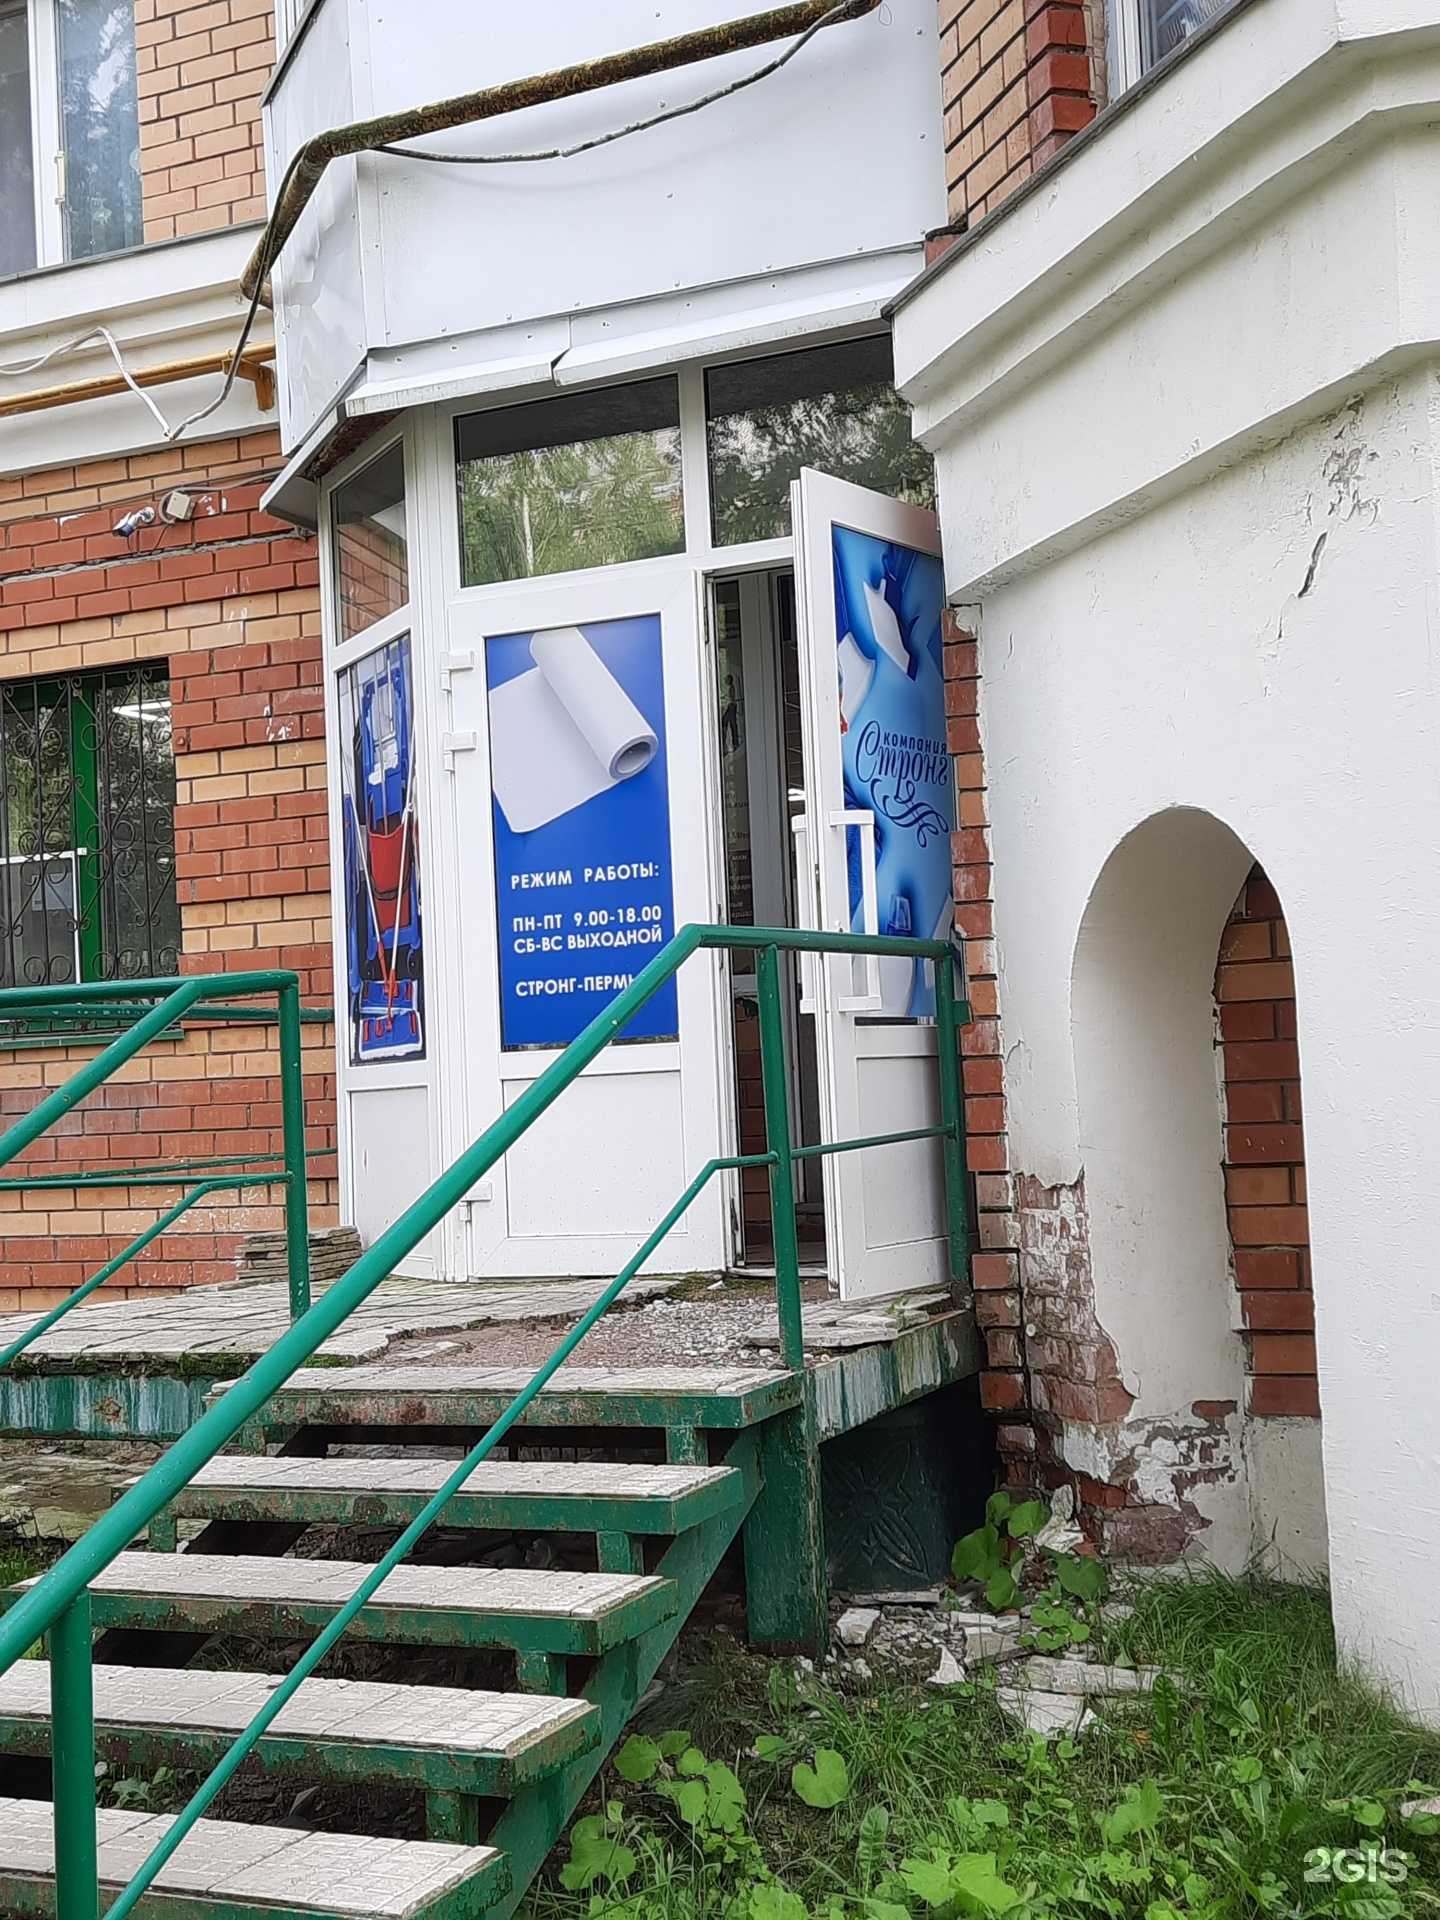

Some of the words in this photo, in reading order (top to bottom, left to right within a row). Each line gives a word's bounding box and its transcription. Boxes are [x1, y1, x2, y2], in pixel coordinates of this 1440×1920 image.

[855, 720, 948, 801] Стронг
[511, 870, 573, 890] РЕЖИМ
[584, 862, 660, 883] РАБОТЫ:
[512, 914, 563, 932] ПН-ПТ
[574, 905, 662, 927] 9.00-18.00
[514, 936, 563, 954] СБ-ВС
[567, 924, 663, 950] ВЫХОДНОЙ
